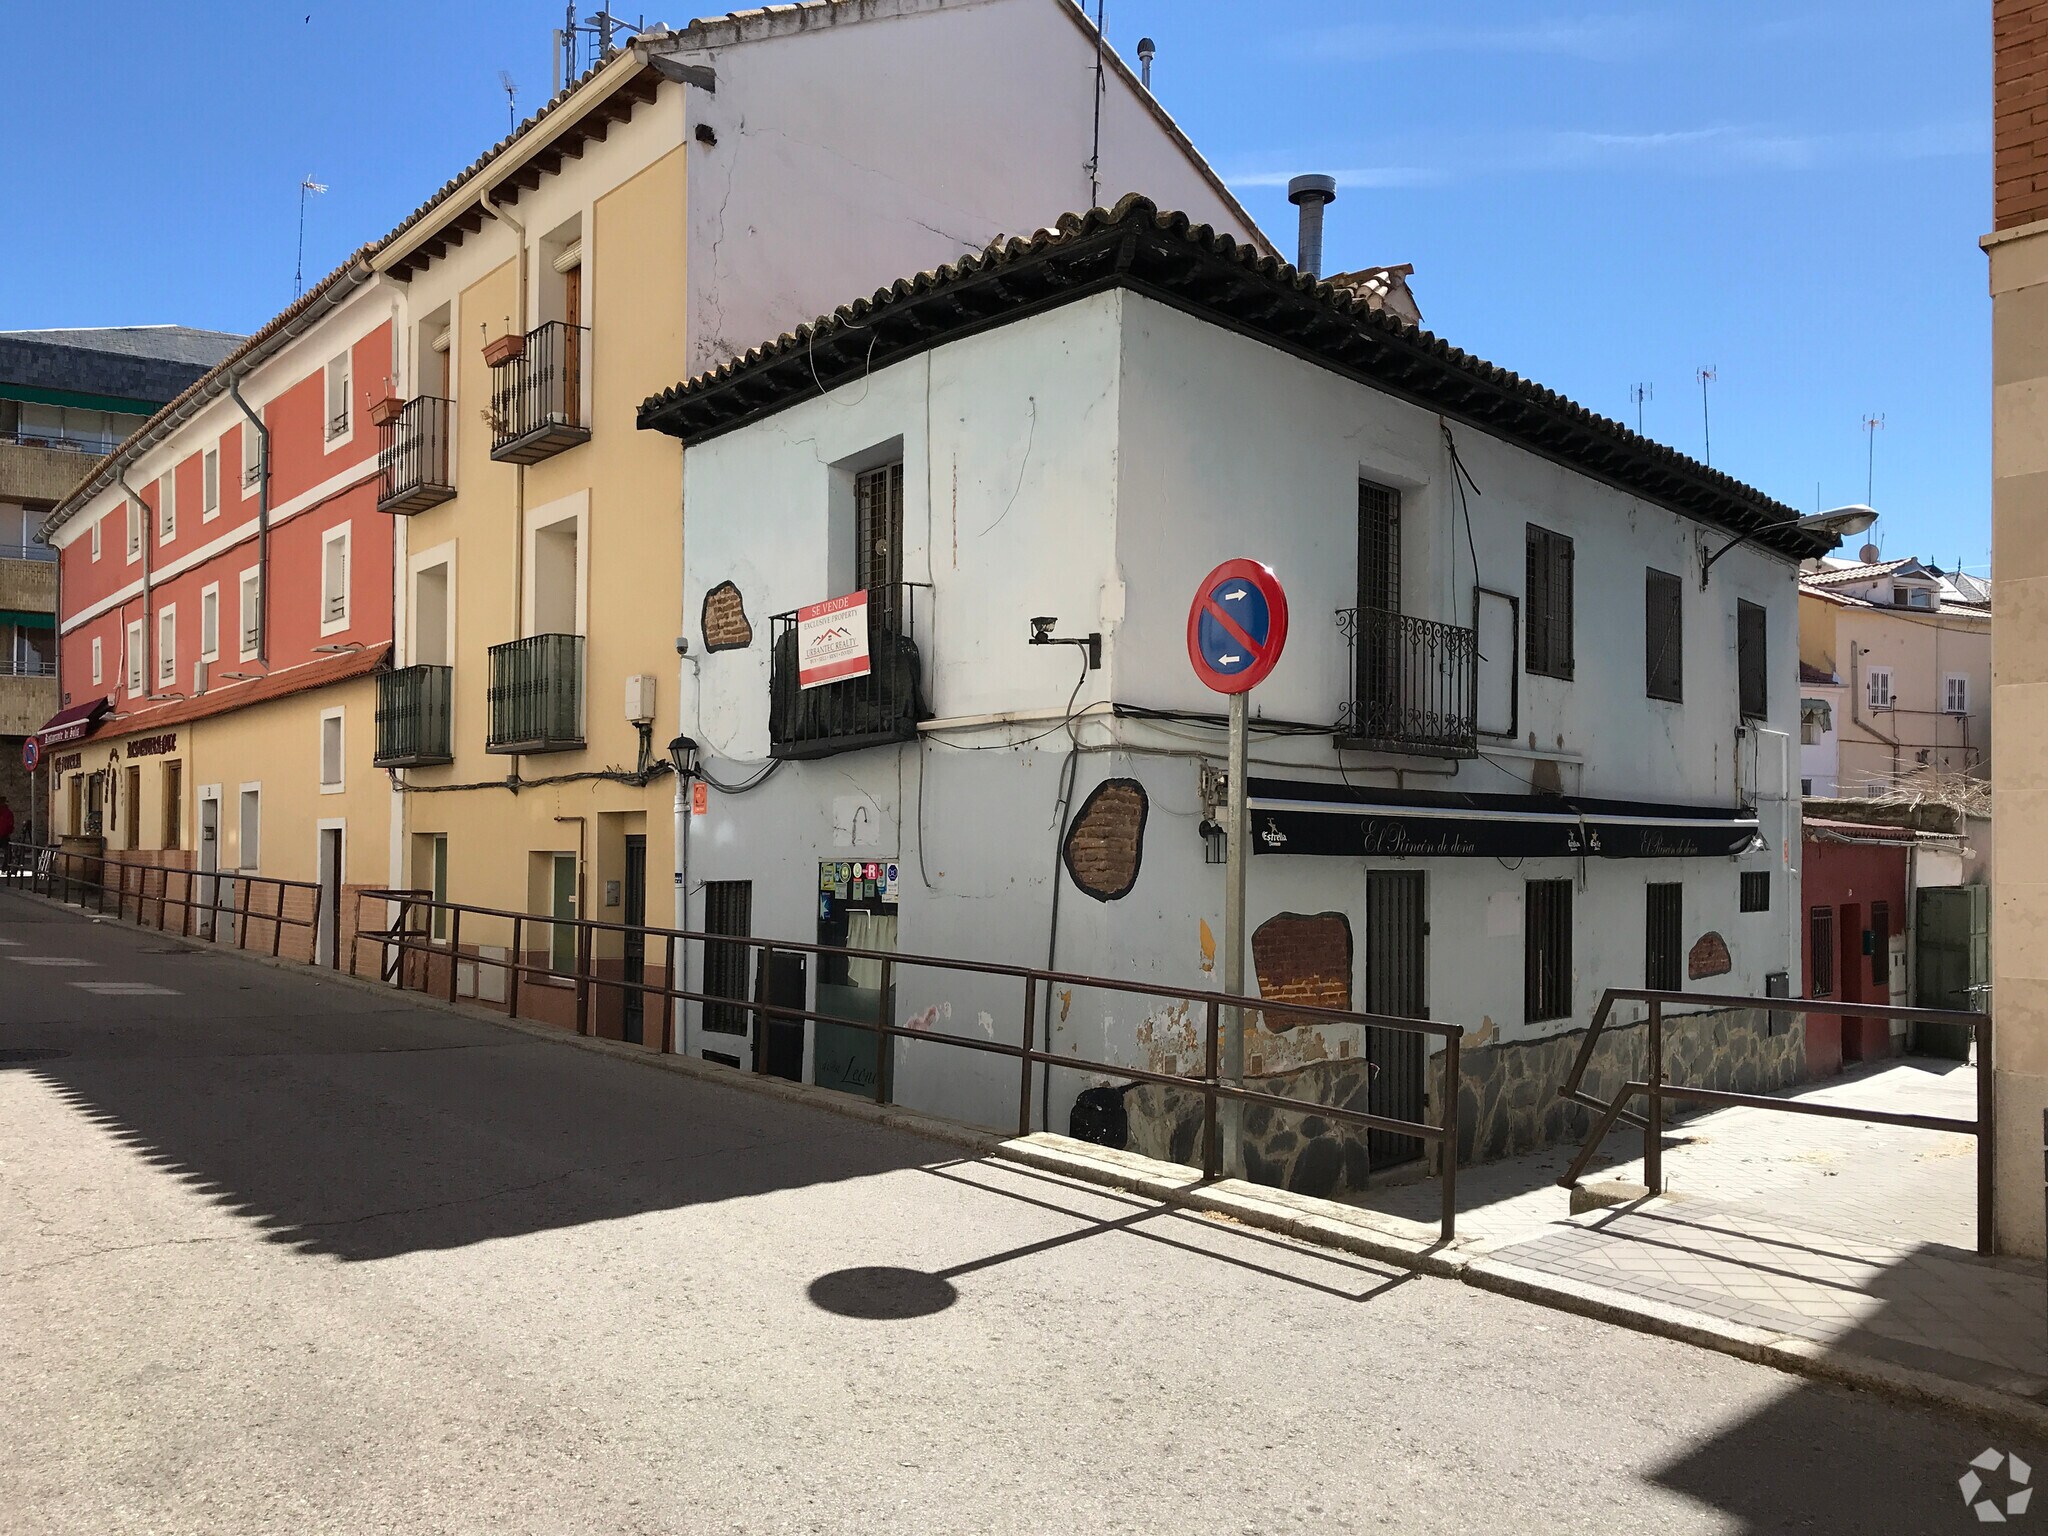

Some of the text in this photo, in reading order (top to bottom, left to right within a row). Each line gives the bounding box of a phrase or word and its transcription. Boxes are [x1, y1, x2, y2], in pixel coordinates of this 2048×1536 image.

[811, 597, 849, 617] SE VENDE
[804, 610, 858, 630] EXCLUSIVE PROPERTY
[806, 637, 857, 658] URBANTEC REALTY
[1261, 830, 1288, 842] Estrella
[1360, 819, 1476, 854] El Rincón de doña
[868, 864, 876, 877] R
